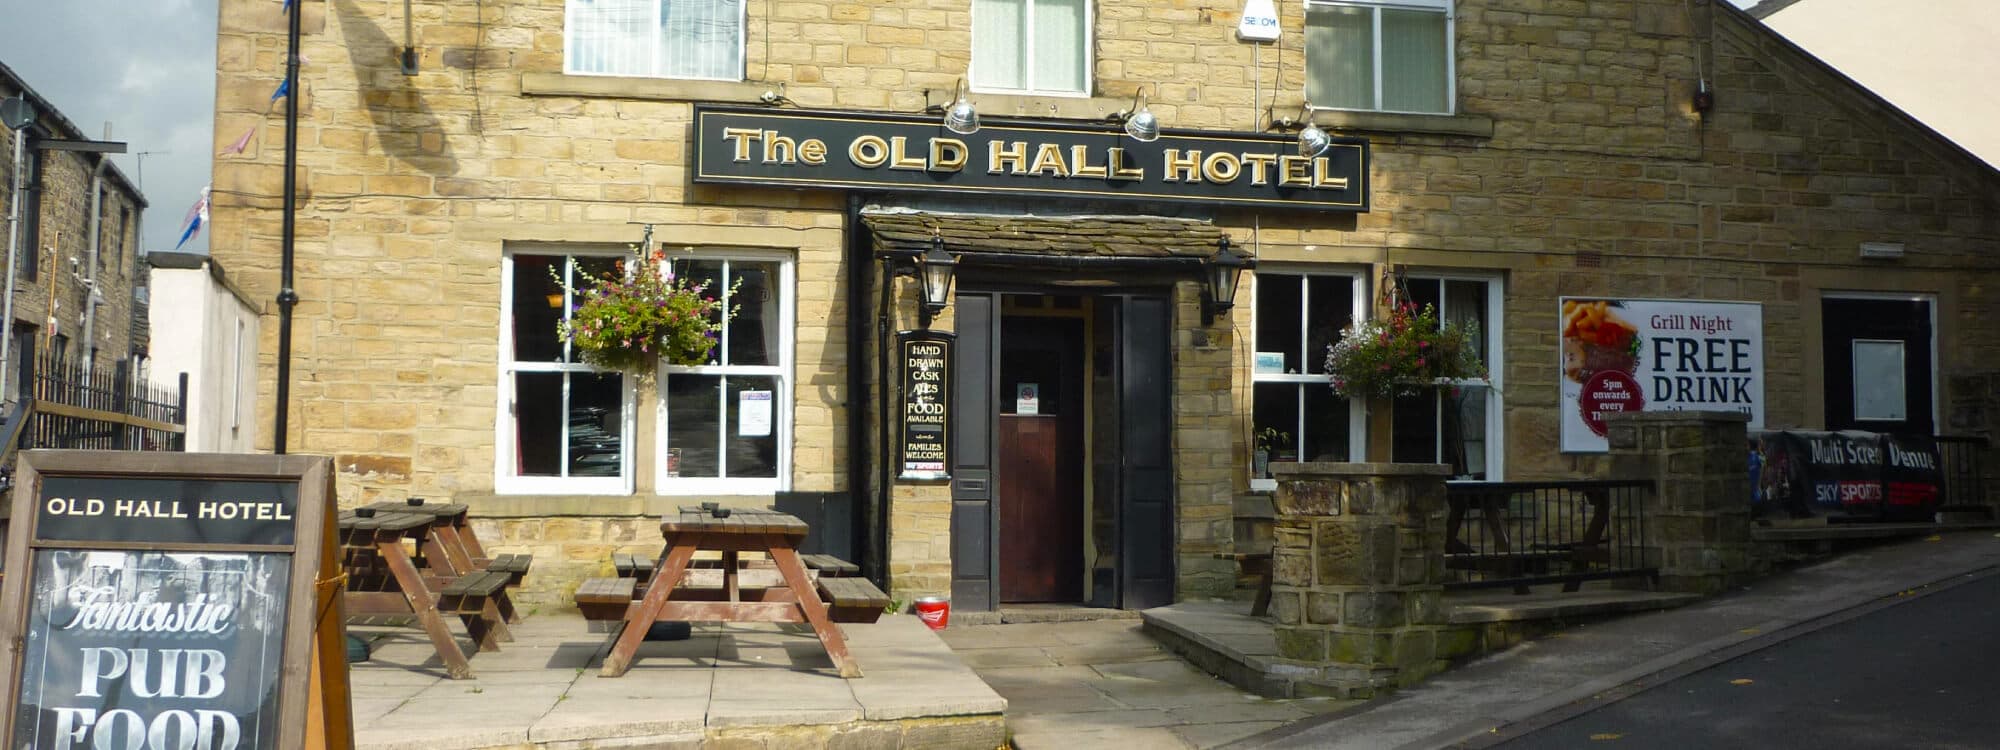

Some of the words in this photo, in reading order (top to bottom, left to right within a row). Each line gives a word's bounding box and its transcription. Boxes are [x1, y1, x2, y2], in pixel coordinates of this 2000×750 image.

[1244, 16, 1276, 27] SEOM
[723, 127, 828, 166] The
[848, 135, 969, 173] OLD
[987, 140, 1144, 182] HALL
[1163, 148, 1348, 190] HOTEL
[1651, 314, 1685, 330] Grill
[1689, 315, 1733, 334] Night
[912, 345, 941, 355] HAND
[1651, 337, 1751, 373] FREE
[908, 358, 944, 368] DRAWN
[912, 371, 940, 380] CASK
[1603, 379, 1622, 390] 5pm
[1652, 375, 1752, 403] DRINK
[1592, 390, 1631, 399] onwards
[907, 403, 944, 414] FOOD
[1600, 402, 1624, 412] every
[907, 415, 944, 423] AVAILABLE
[908, 443, 942, 451] FAMILIES
[1811, 439, 1845, 465] Multi
[906, 451, 944, 459] WELCOME
[1816, 484, 1839, 501] SKY
[47, 498, 105, 516] OLD
[115, 500, 188, 518] HALL
[198, 502, 291, 520] HOTEL
[64, 586, 230, 634] Fantastic
[75, 647, 226, 699] PUB
